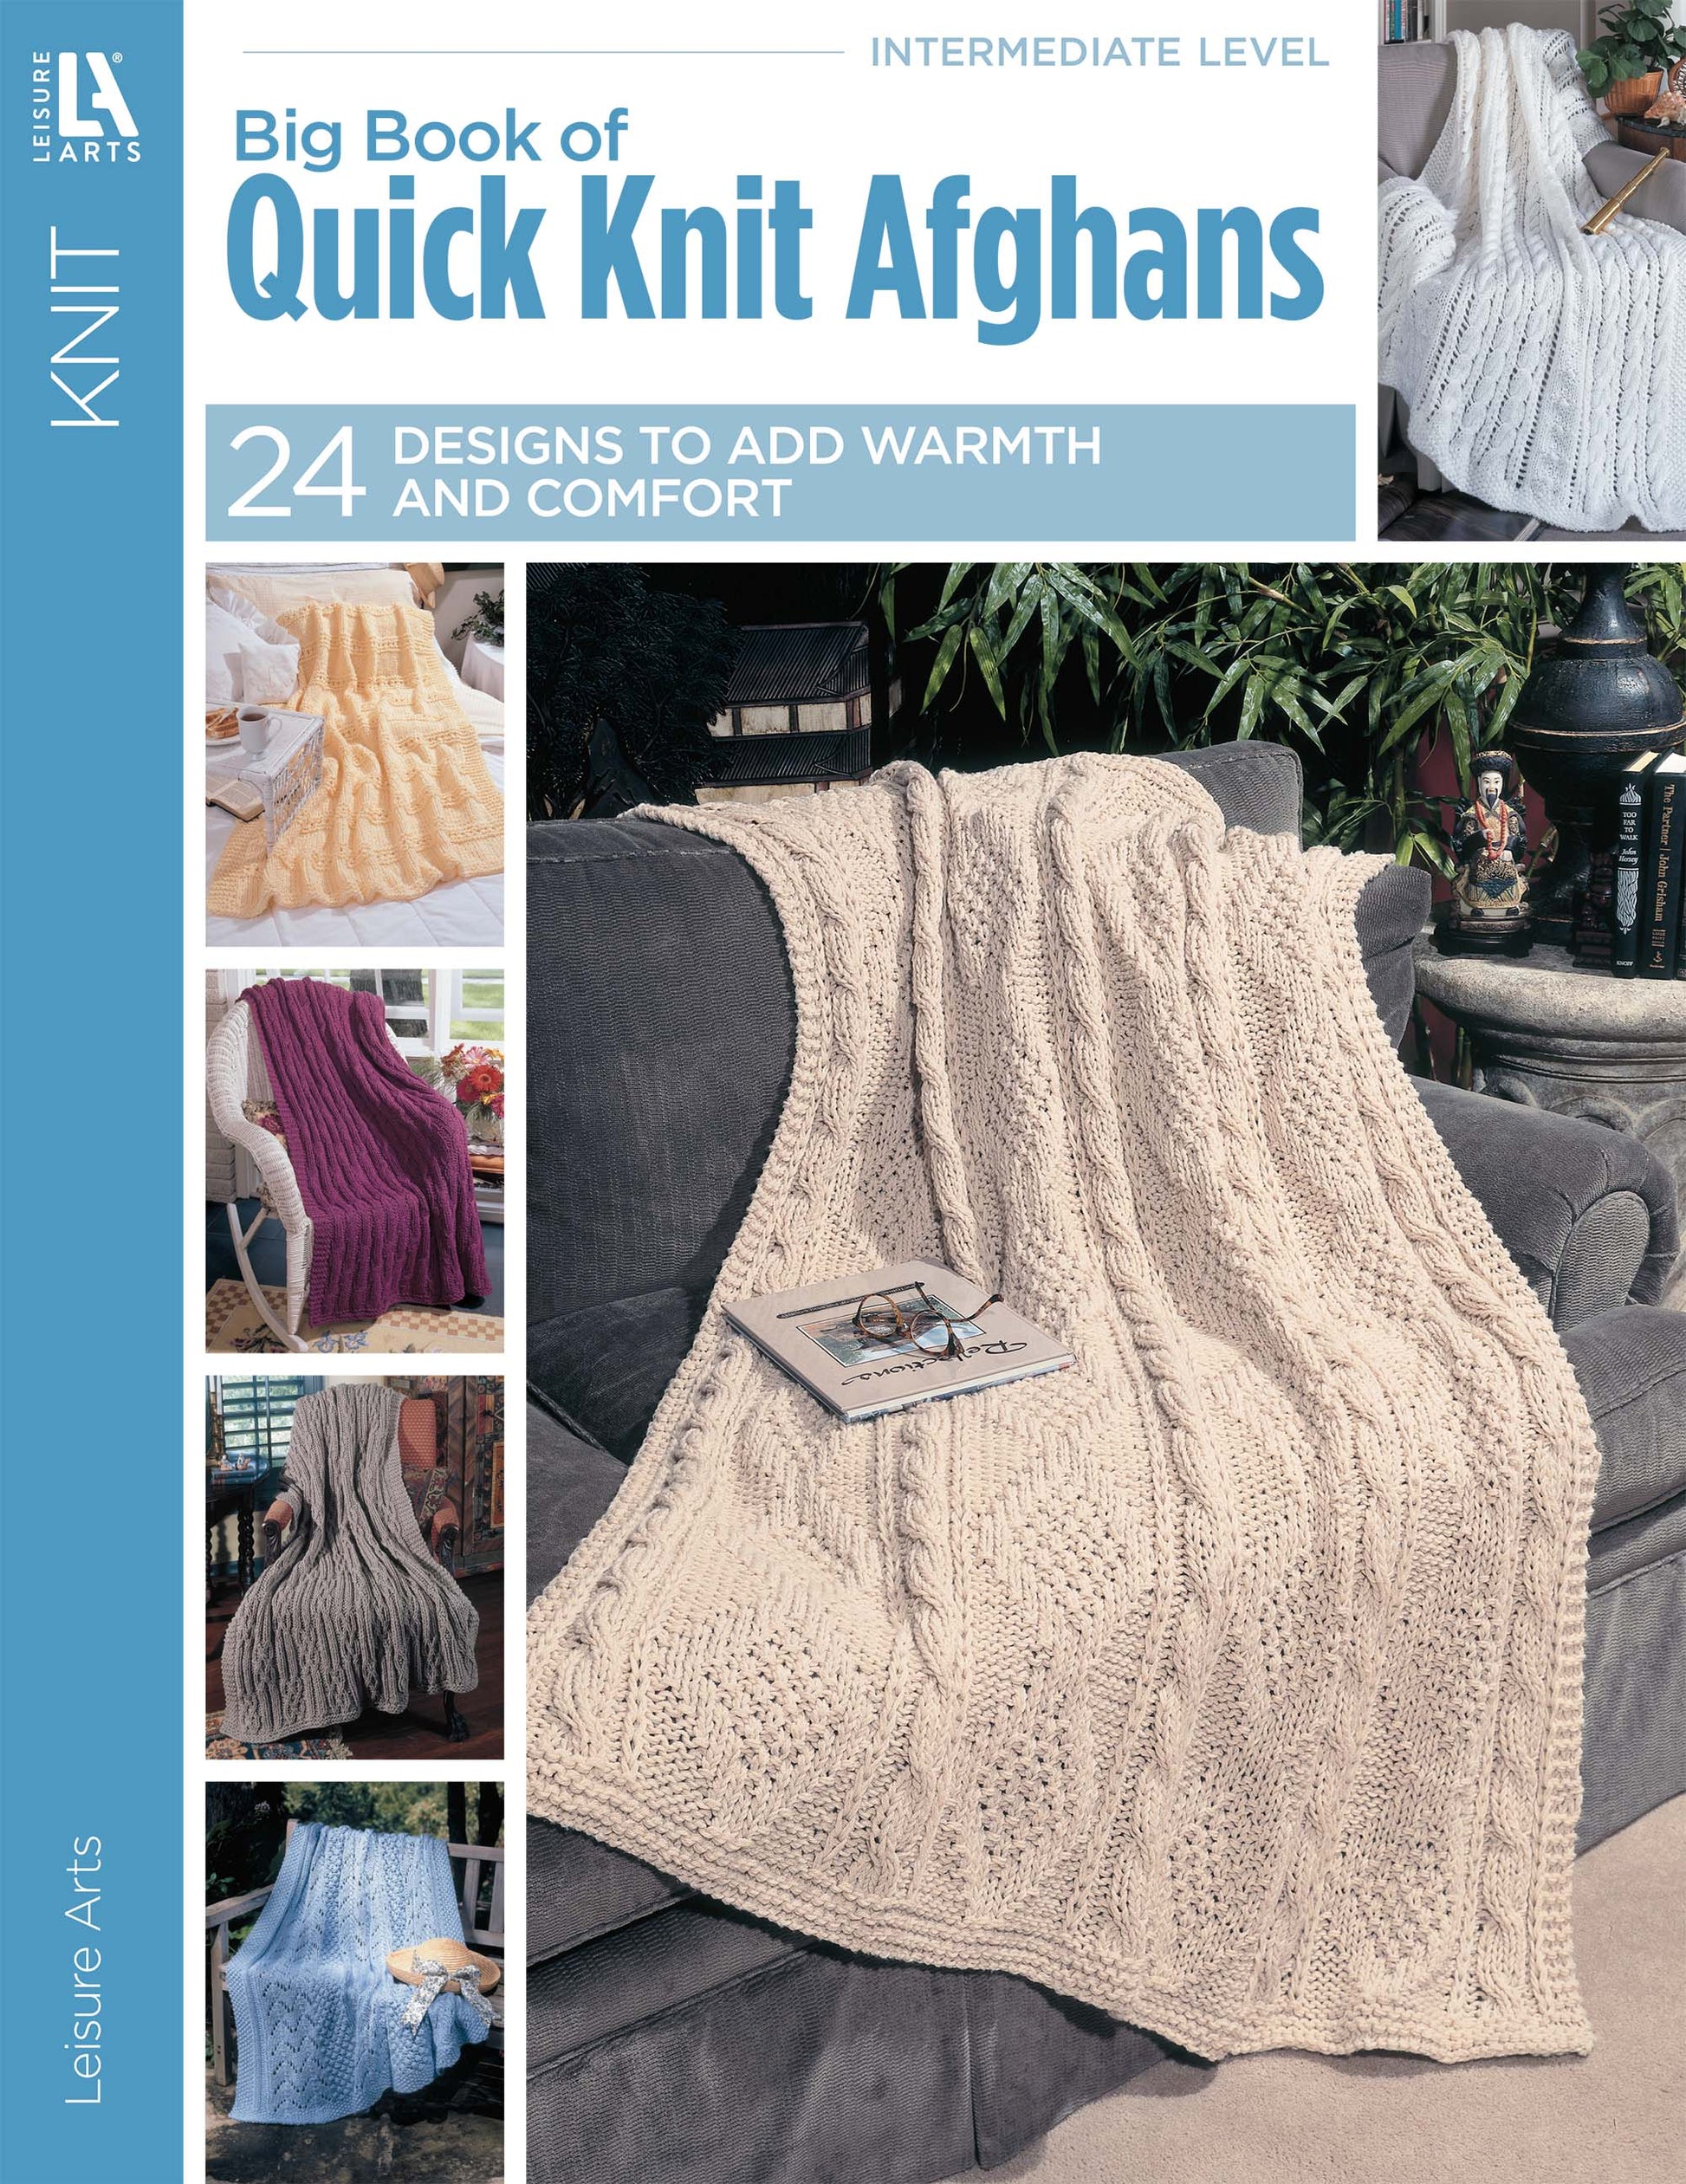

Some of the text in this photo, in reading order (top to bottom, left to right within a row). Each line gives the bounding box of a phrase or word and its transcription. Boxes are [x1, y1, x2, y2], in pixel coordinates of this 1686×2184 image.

[872, 37, 1329, 66] INTERMEDIATE LEVEL
[32, 51, 50, 162] LEISURE
[58, 141, 141, 163] ARTS
[236, 107, 629, 173] Big Book of
[226, 173, 1325, 347] Quick Knit Afghans
[50, 225, 120, 427] KNIT
[394, 425, 1100, 465] DESIGNS TO ADD WARMTH
[227, 425, 366, 517] 24
[392, 478, 793, 518] AND COMFORT
[1663, 784, 1676, 803] The
[1660, 807, 1673, 845] Partner
[1658, 854, 1670, 878] John
[1655, 880, 1668, 922] Grisham
[64, 1836, 102, 2103] Leisure Arts
